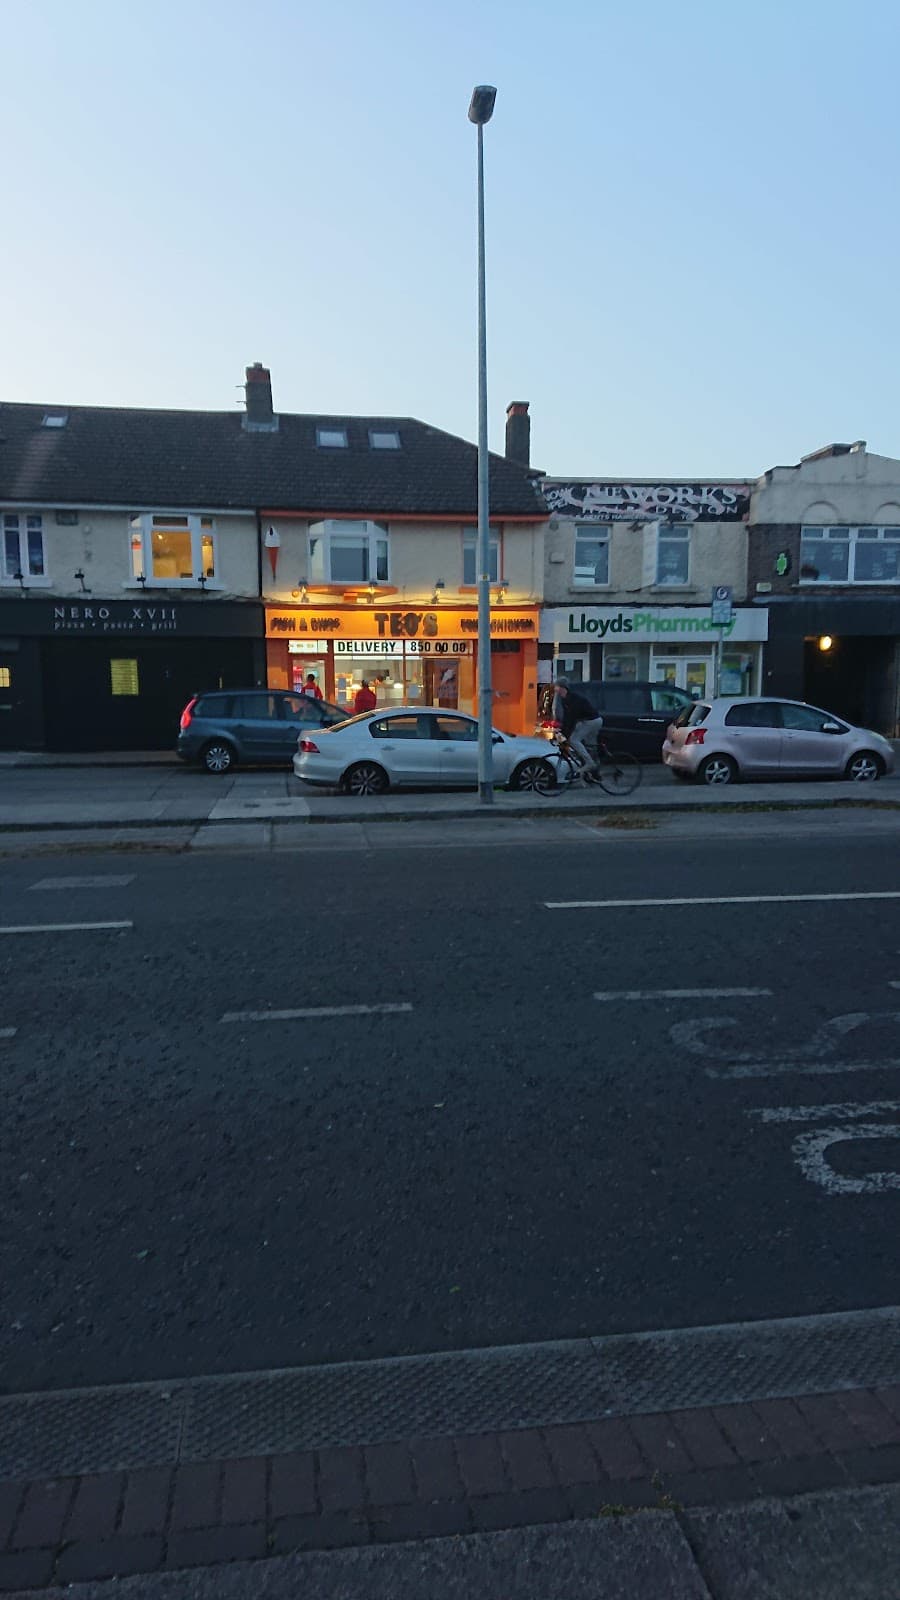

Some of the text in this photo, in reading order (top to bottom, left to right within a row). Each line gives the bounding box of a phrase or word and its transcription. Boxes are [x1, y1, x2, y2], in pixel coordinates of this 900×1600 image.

[54, 607, 176, 619] NERO XVII
[270, 618, 340, 631] FISH & CHIPS
[374, 612, 439, 637] TEO'S
[337, 641, 396, 652] DELIVERY
[410, 641, 431, 652] 850
